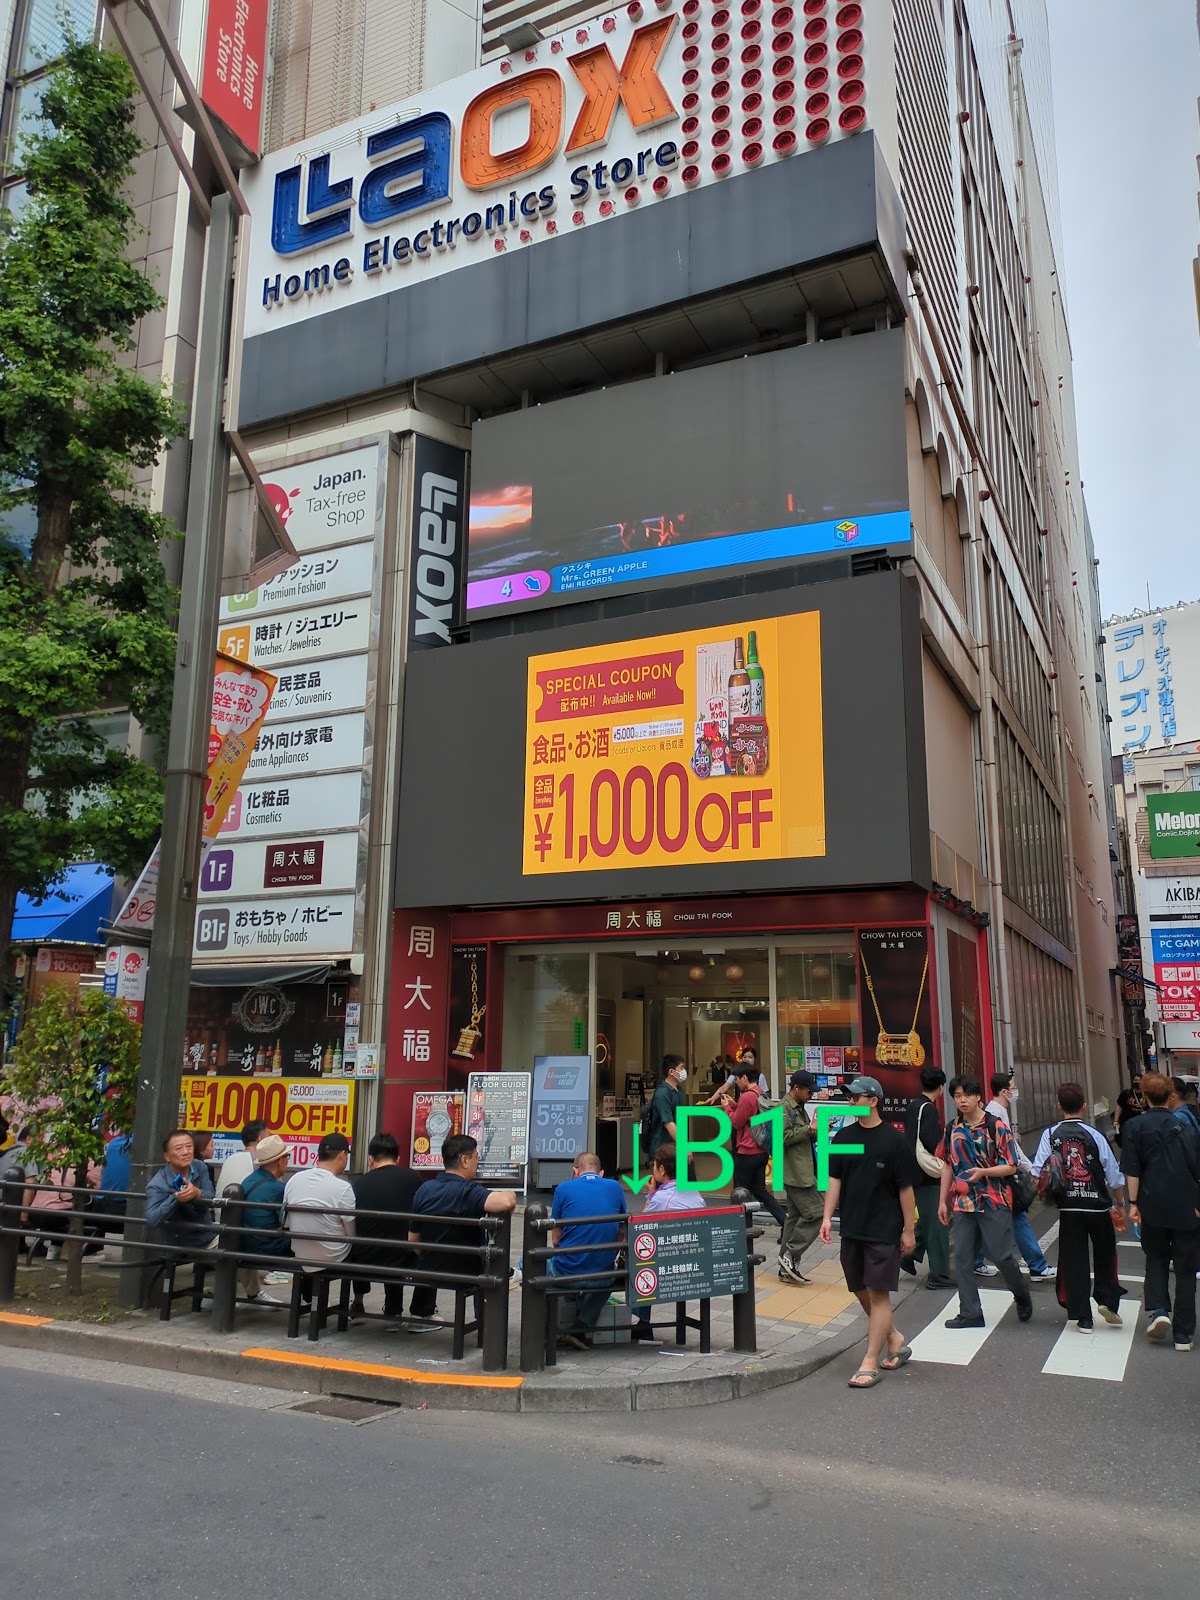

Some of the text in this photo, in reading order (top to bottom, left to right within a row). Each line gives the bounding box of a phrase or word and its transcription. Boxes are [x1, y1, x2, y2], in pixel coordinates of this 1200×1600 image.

[217, 27, 232, 83] Store
[243, 54, 258, 110] Home
[263, 141, 679, 309] Home Electronics Store
[313, 467, 366, 491] Japan.
[306, 487, 366, 514] Tax-free
[326, 508, 365, 527] Shop
[561, 562, 592, 574] クスシキ
[561, 561, 648, 583] Mrs. GREEN APPLE
[263, 585, 298, 601] Premium
[298, 580, 326, 594] Fashion
[501, 581, 511, 597] 4
[576, 576, 612, 587] RECORDS
[255, 612, 358, 641] 時計 ジュエリー
[226, 636, 244, 656] 5F
[254, 636, 321, 657] Watches Jewelries
[546, 662, 672, 695] SPECIAL COUPON
[1114, 624, 1151, 748] テレオン
[1152, 619, 1177, 738] オーディオ専門店
[295, 690, 332, 706] Souvenirs
[602, 691, 634, 706] Available
[636, 688, 656, 701] Now!!
[533, 728, 609, 765] 食品・お酒
[612, 746, 628, 754] Foods
[269, 750, 309, 768] Appliances
[535, 779, 552, 794] 全品
[247, 789, 290, 809] 化粧品
[222, 804, 236, 823] F
[246, 811, 282, 825] Cosmetics
[695, 789, 773, 852] OFF
[273, 849, 315, 867] 周大福
[209, 860, 226, 883] 1F
[235, 906, 342, 928] おもちゃ ホビー
[606, 910, 661, 930] 周大福
[200, 920, 226, 943] B1F
[234, 927, 308, 947] Toys Hobby Goods
[1160, 940, 1200, 948] PC GAM
[332, 993, 342, 1006] 1F
[403, 926, 435, 1062] 周大福
[416, 1095, 453, 1104] OMEGA
[474, 1094, 482, 1102] 4F
[286, 1104, 348, 1133] OFF!!
[658, 1233, 699, 1245] 路上喫煙禁止
[658, 1262, 700, 1275] 路上駐輪禁止
